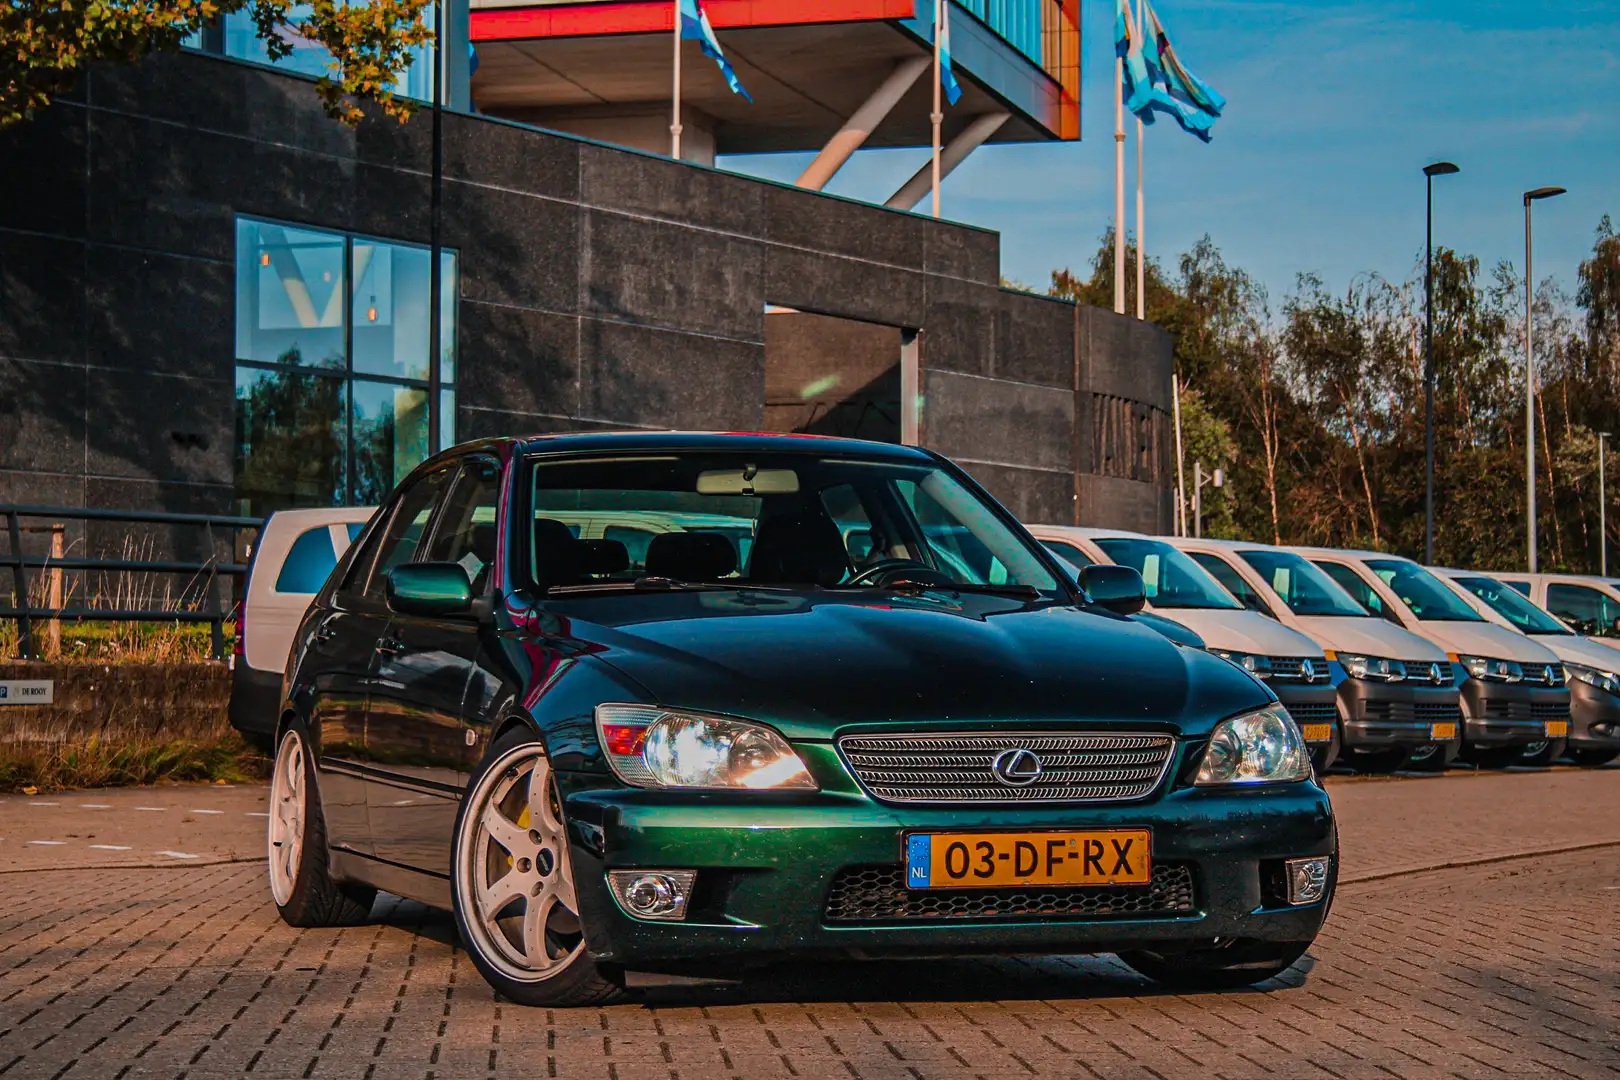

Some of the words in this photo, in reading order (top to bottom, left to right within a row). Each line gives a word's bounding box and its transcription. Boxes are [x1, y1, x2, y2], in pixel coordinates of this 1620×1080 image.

[22, 687, 30, 696] DE
[31, 687, 47, 696] ROOY
[944, 838, 1134, 880] 03-DF-RX
[911, 866, 928, 879] NL
